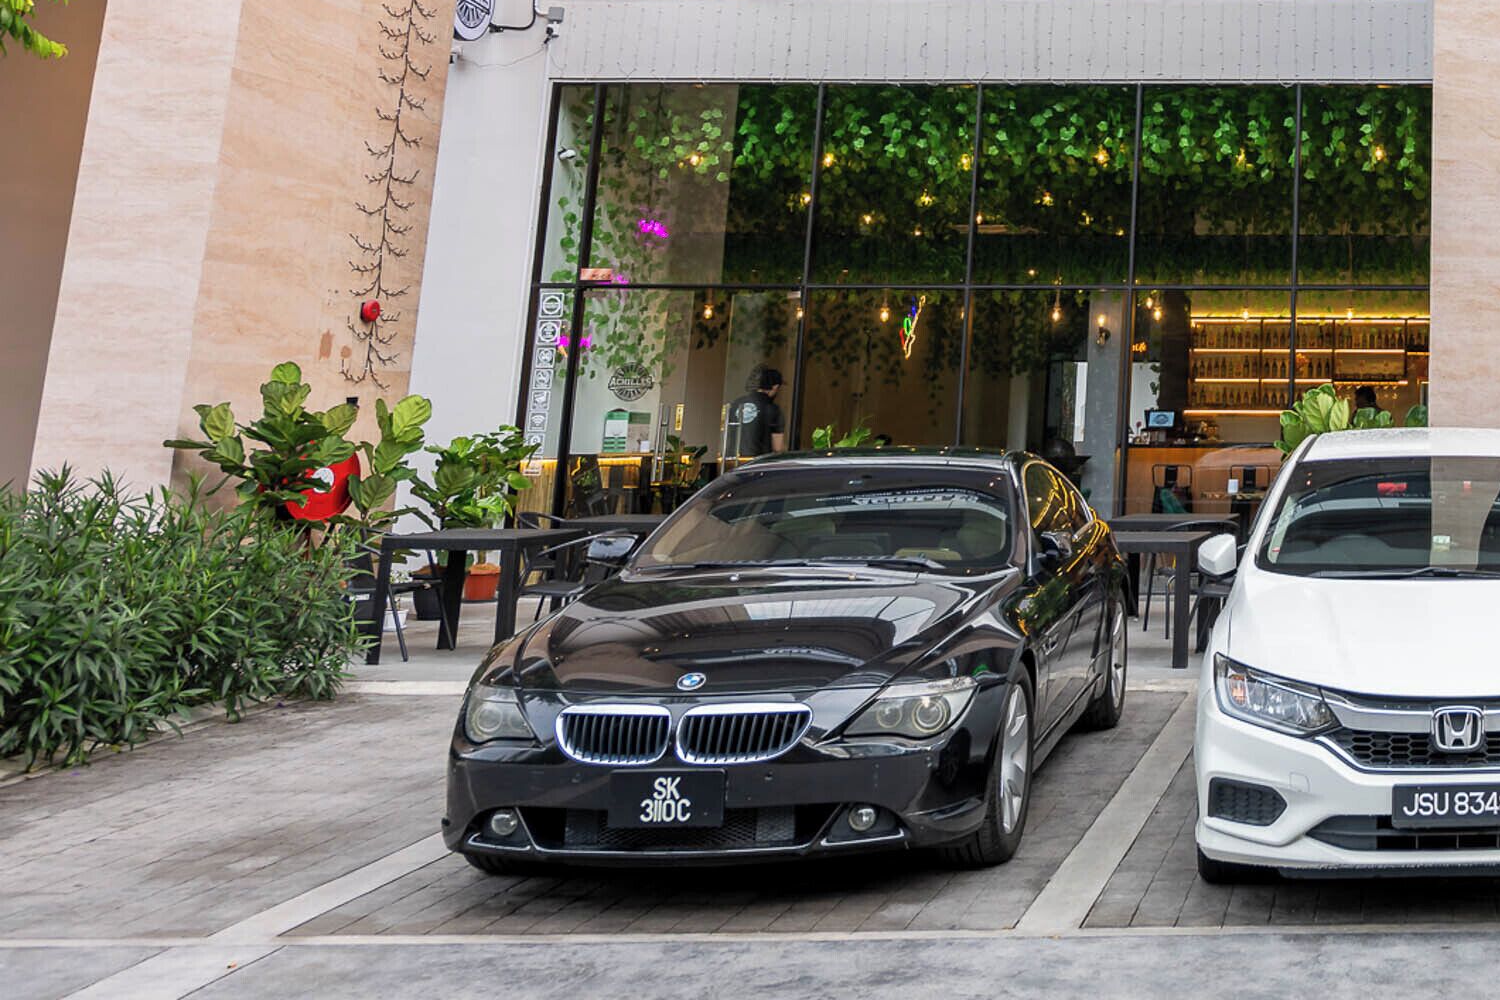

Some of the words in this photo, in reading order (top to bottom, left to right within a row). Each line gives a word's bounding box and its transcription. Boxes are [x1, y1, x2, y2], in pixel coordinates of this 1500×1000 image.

[653, 777, 681, 800] SK
[640, 799, 691, 822] 3110C
[1403, 792, 1449, 816] JSU
